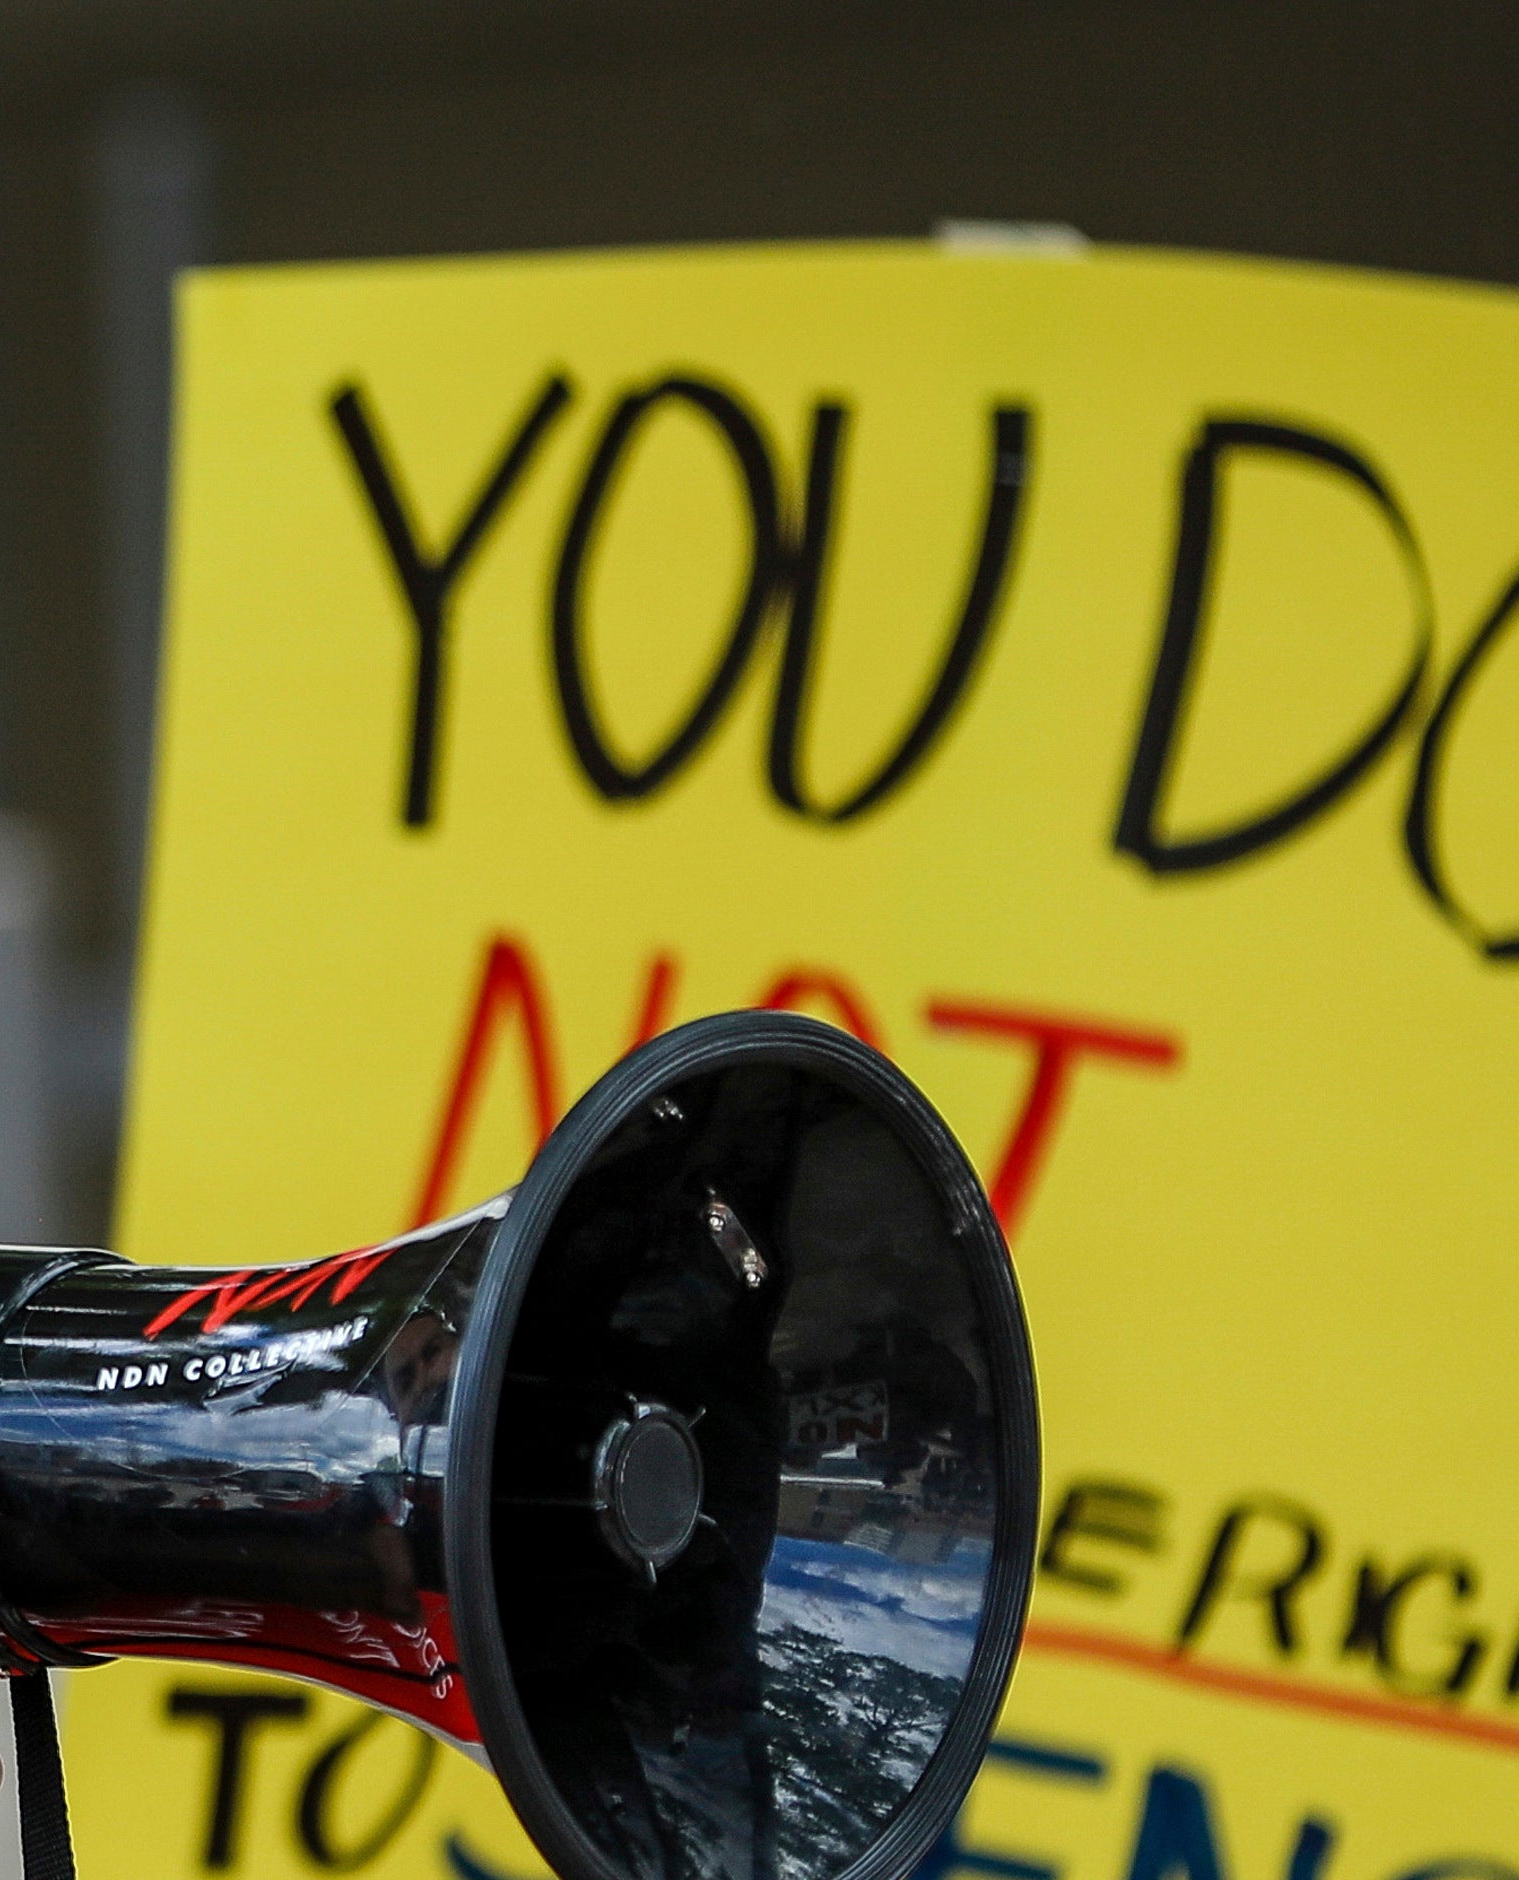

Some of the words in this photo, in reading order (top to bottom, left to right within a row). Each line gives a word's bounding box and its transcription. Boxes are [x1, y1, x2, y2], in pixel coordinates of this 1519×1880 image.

[327, 370, 1035, 832] YOU
[405, 933, 1181, 1245] NT
[96, 1361, 170, 1391] NDN
[182, 1315, 370, 1382] COLLECTIVE
[163, 1688, 439, 1873] TO
